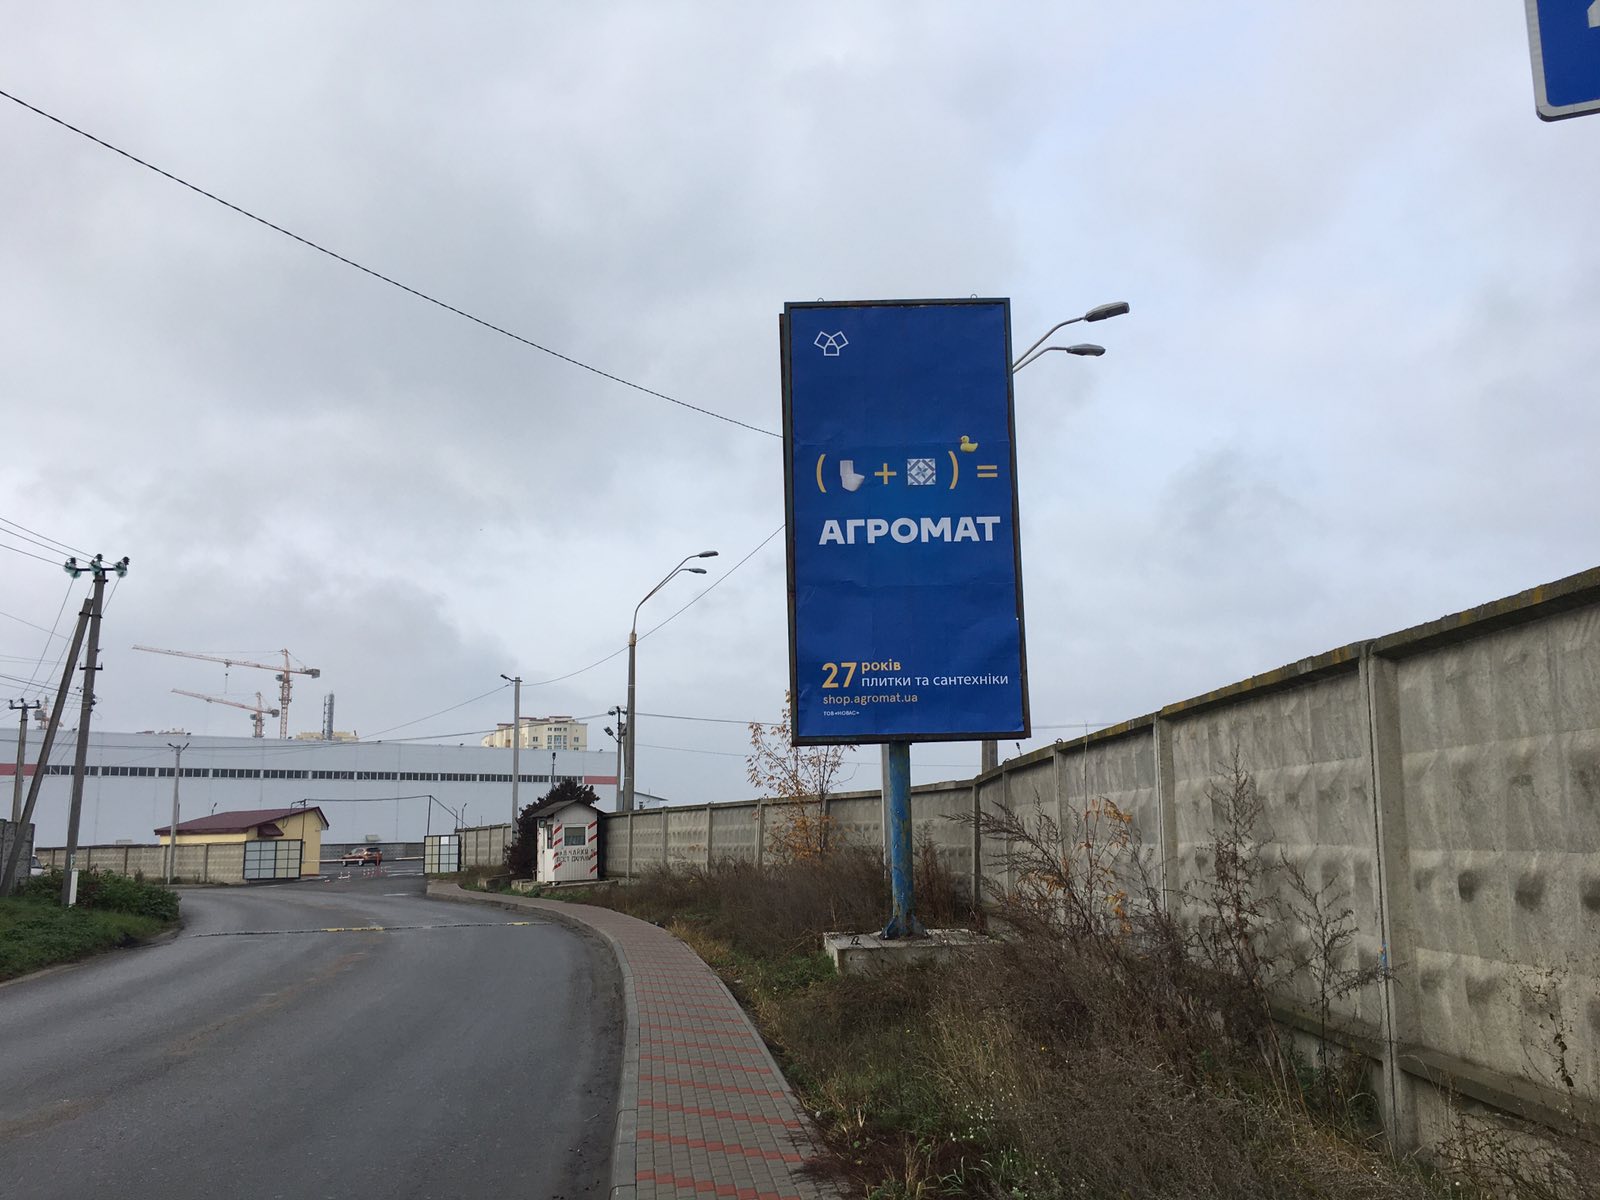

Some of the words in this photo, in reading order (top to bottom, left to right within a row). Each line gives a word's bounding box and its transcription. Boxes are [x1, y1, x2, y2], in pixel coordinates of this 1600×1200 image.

[818, 516, 1001, 545] АГРОМАТ
[821, 662, 857, 689] 27
[861, 658, 902, 674] років
[861, 676, 911, 687] плитки
[914, 675, 930, 687] та
[933, 673, 1009, 686] сантехніки
[823, 692, 918, 706] shop.agromat.ua
